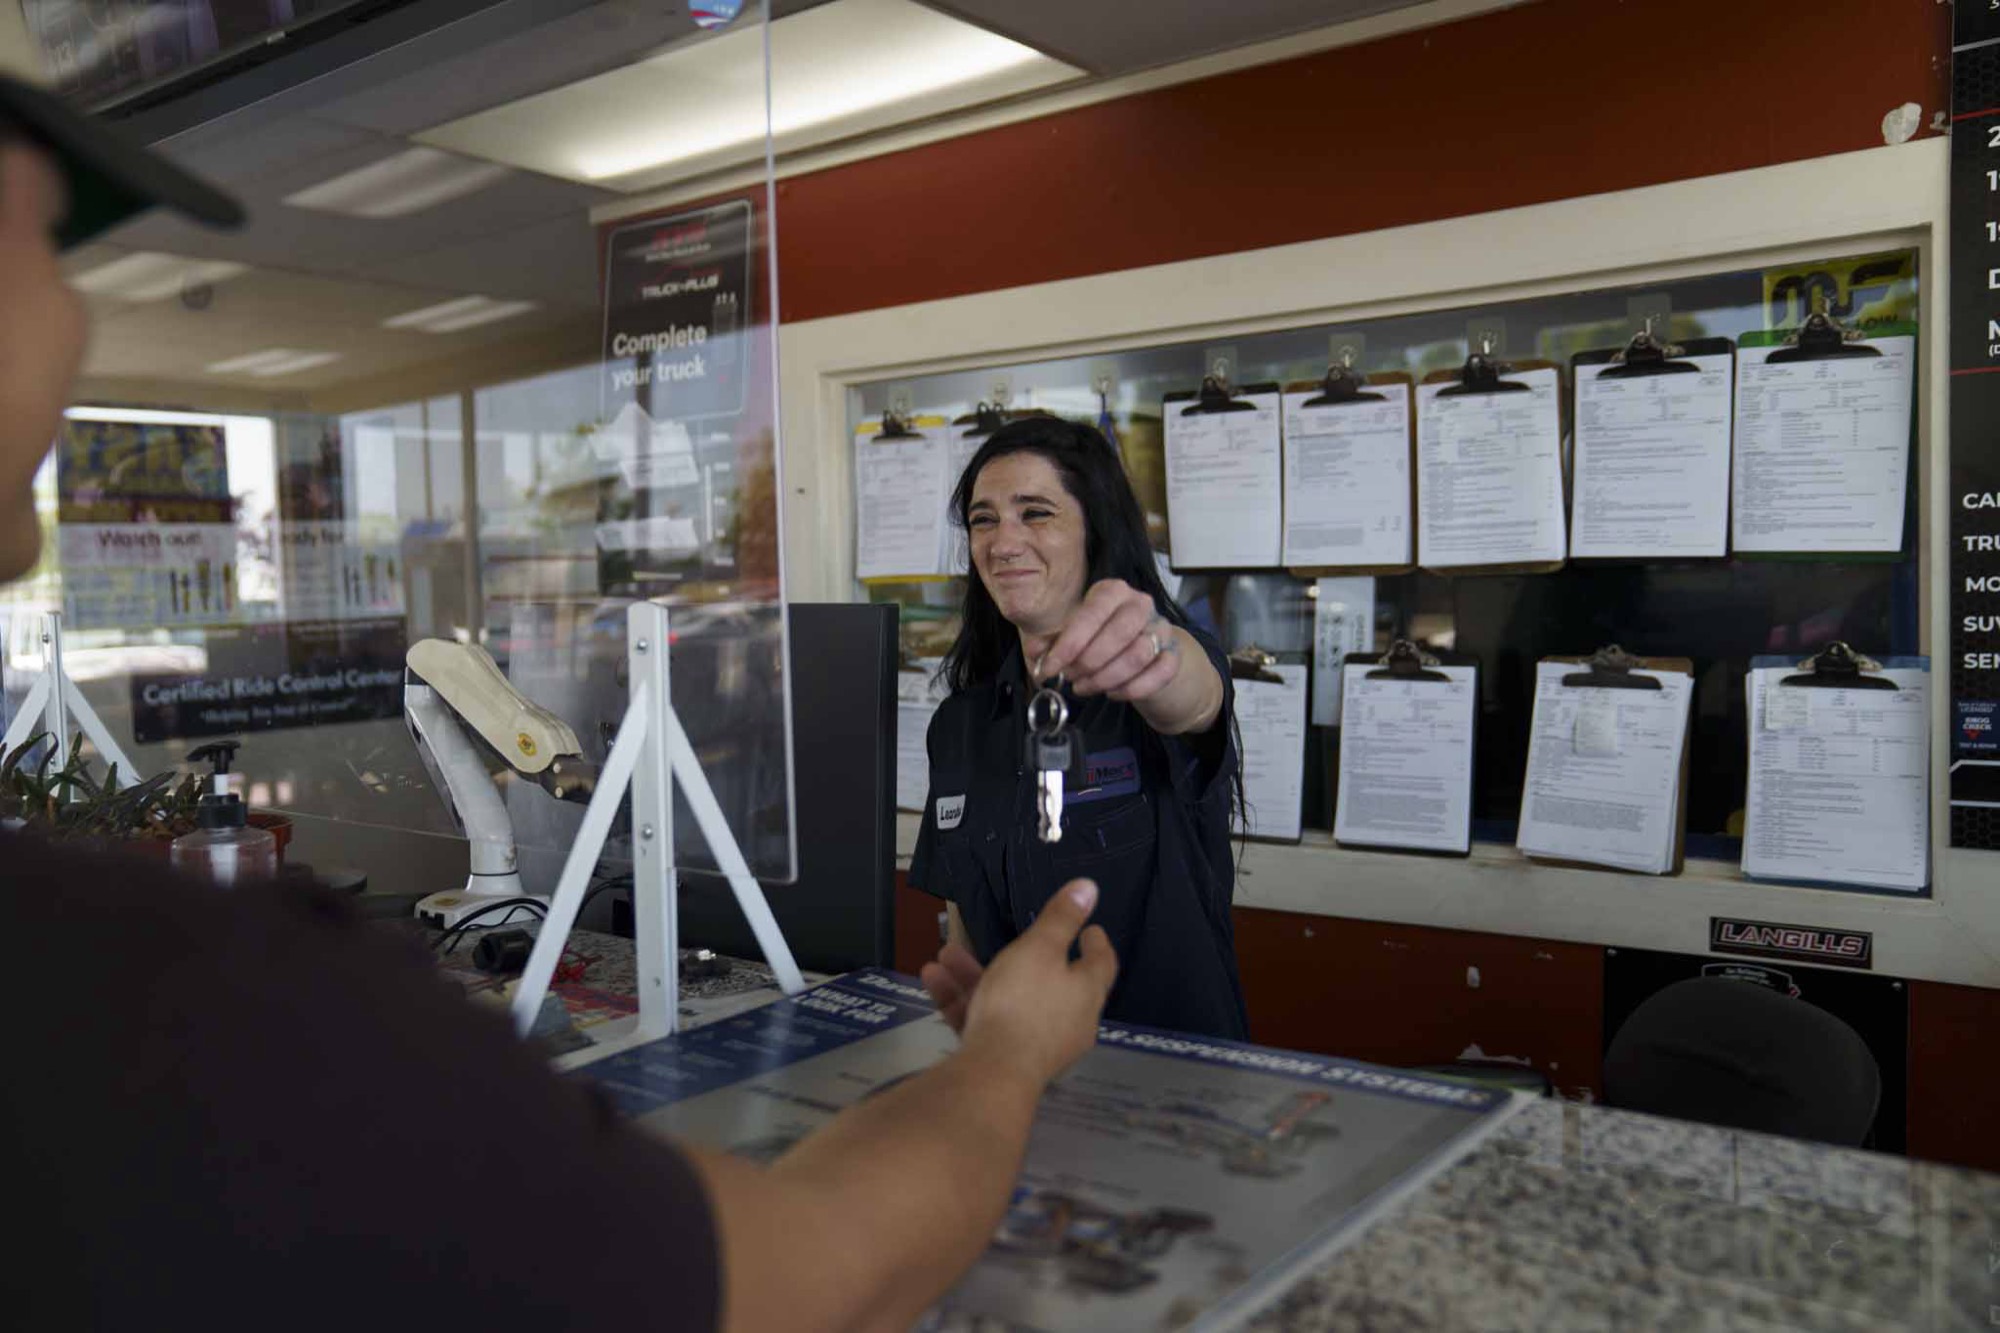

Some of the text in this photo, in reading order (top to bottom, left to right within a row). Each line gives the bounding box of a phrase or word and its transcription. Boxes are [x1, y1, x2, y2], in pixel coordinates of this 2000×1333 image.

[613, 323, 707, 356] Complete
[611, 352, 706, 391] your truck
[1962, 492, 2000, 509] CA
[143, 668, 400, 706] Certified Ride Control Center
[1720, 922, 1862, 955] LANGILLS
[1125, 1033, 1324, 1075] SUSPENSION
